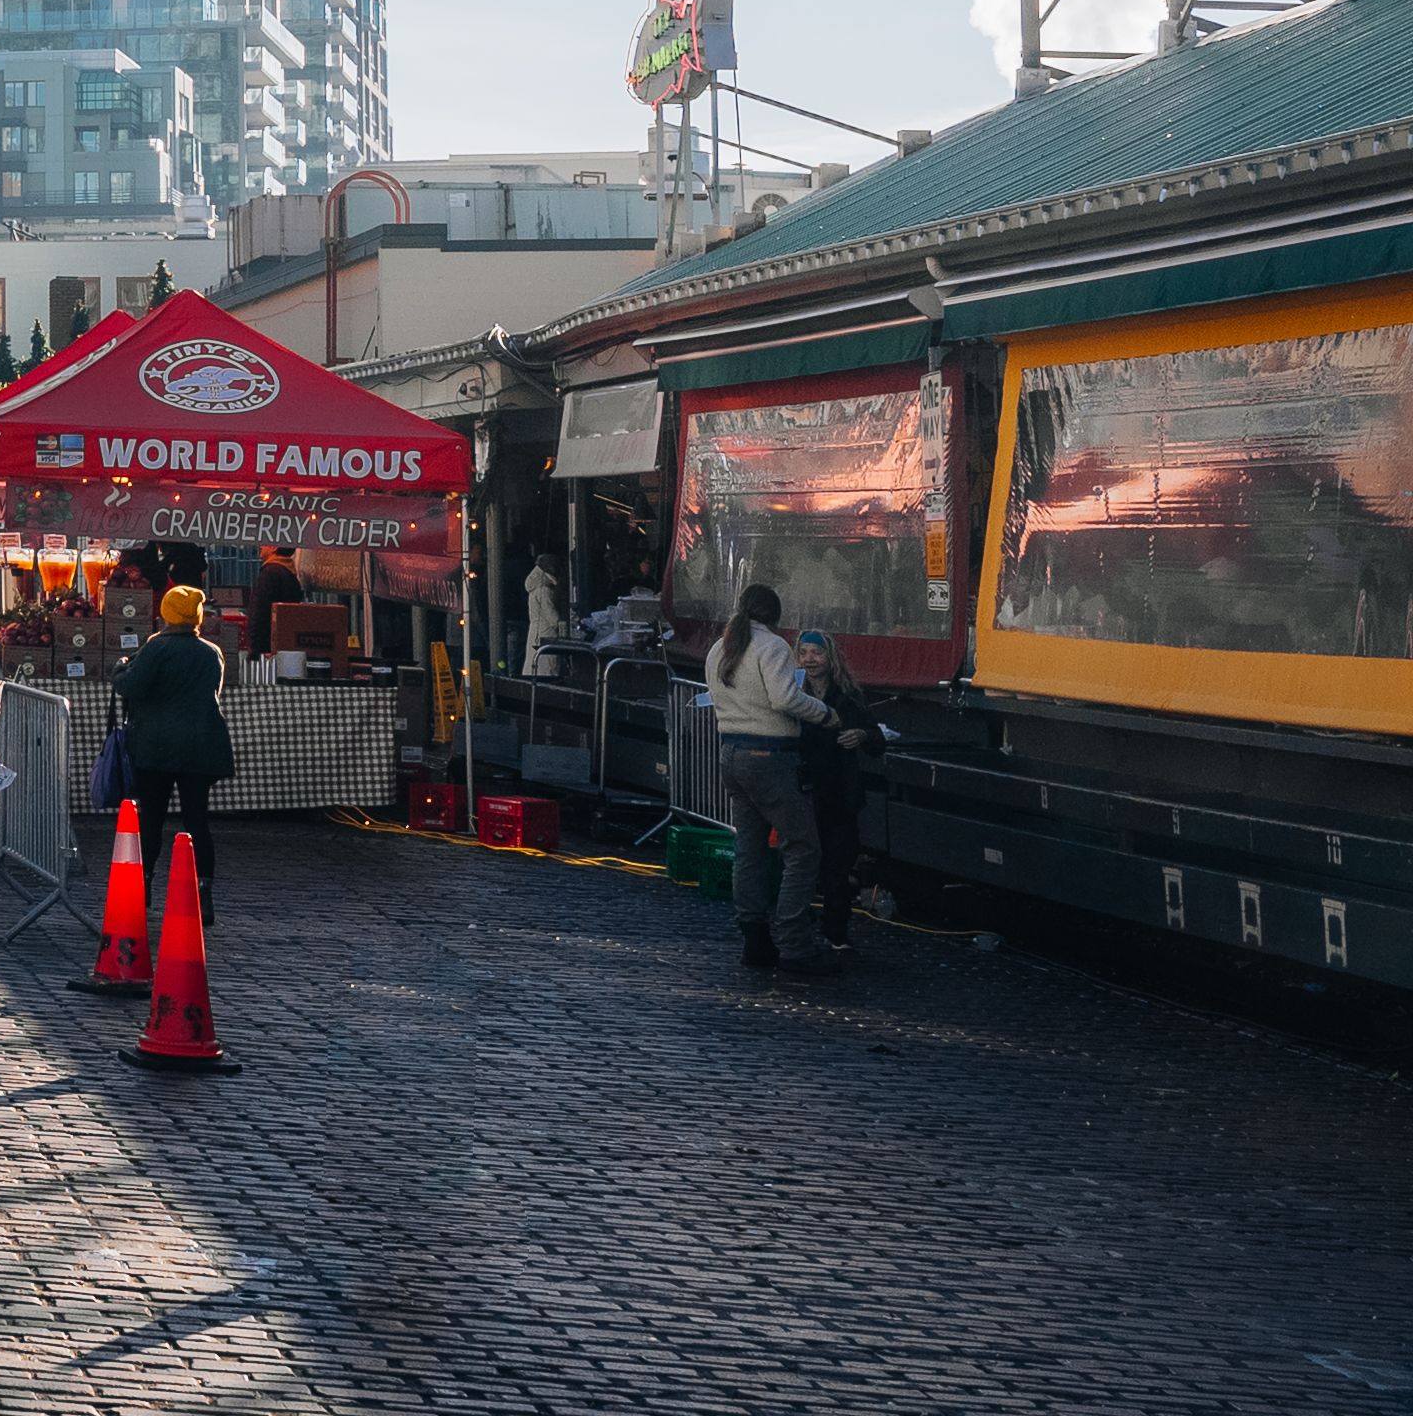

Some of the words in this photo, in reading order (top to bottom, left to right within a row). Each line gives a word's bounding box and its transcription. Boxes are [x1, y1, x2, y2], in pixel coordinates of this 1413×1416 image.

[156, 343, 250, 365] TINY'S
[163, 393, 264, 410] ORGANIC
[923, 379, 939, 411] ONE
[923, 414, 940, 442] WAY
[99, 436, 244, 471] WORLD
[256, 443, 423, 482] FAMOUS
[207, 491, 341, 513] ORGANIC
[151, 507, 311, 545] CRANBERRY
[317, 517, 402, 549] CIDER
[1326, 834, 1342, 865] 10
